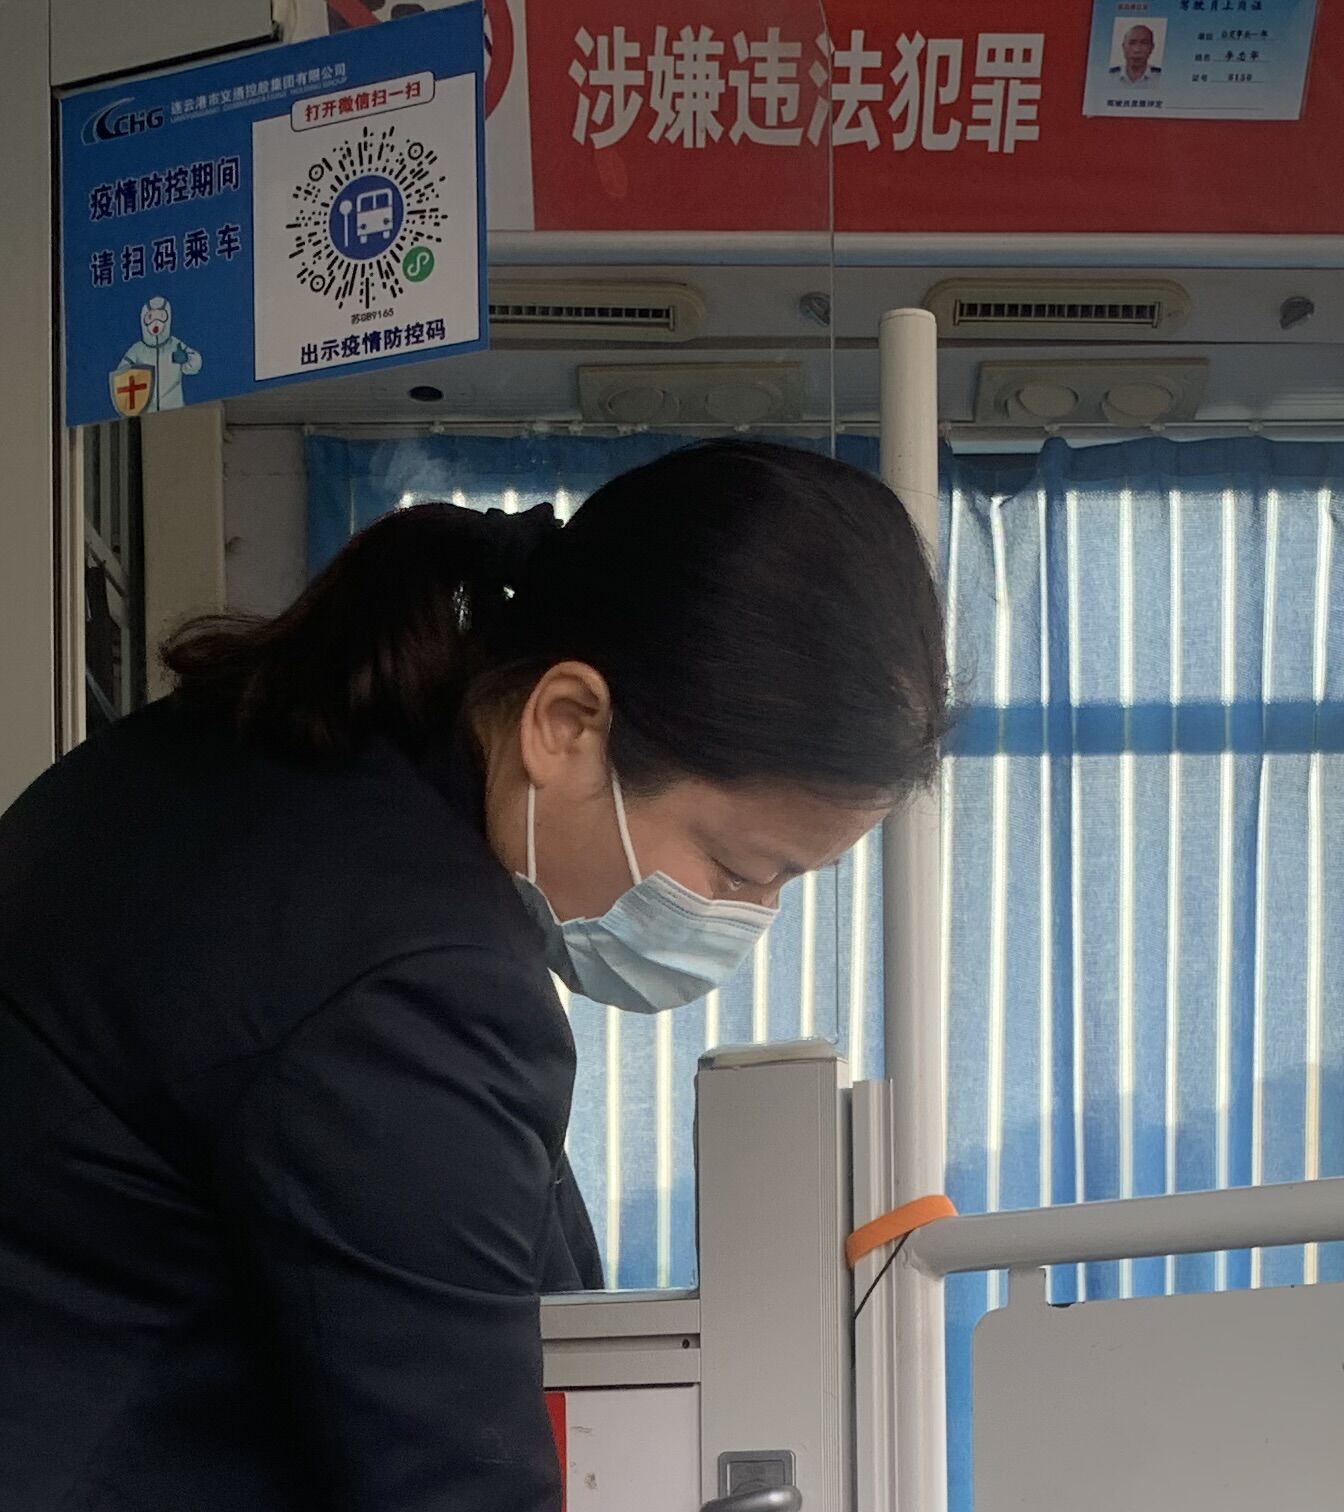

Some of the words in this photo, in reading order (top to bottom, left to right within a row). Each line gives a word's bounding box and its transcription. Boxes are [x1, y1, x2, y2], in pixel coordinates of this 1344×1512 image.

[304, 82, 422, 122] 打开微信扫一扫
[569, 25, 1046, 154] 涉嫌违法犯罪
[89, 156, 241, 221] 疫情防控期间
[89, 224, 242, 287] 请扫码乘车
[300, 318, 446, 366] 出示疫情防控码
